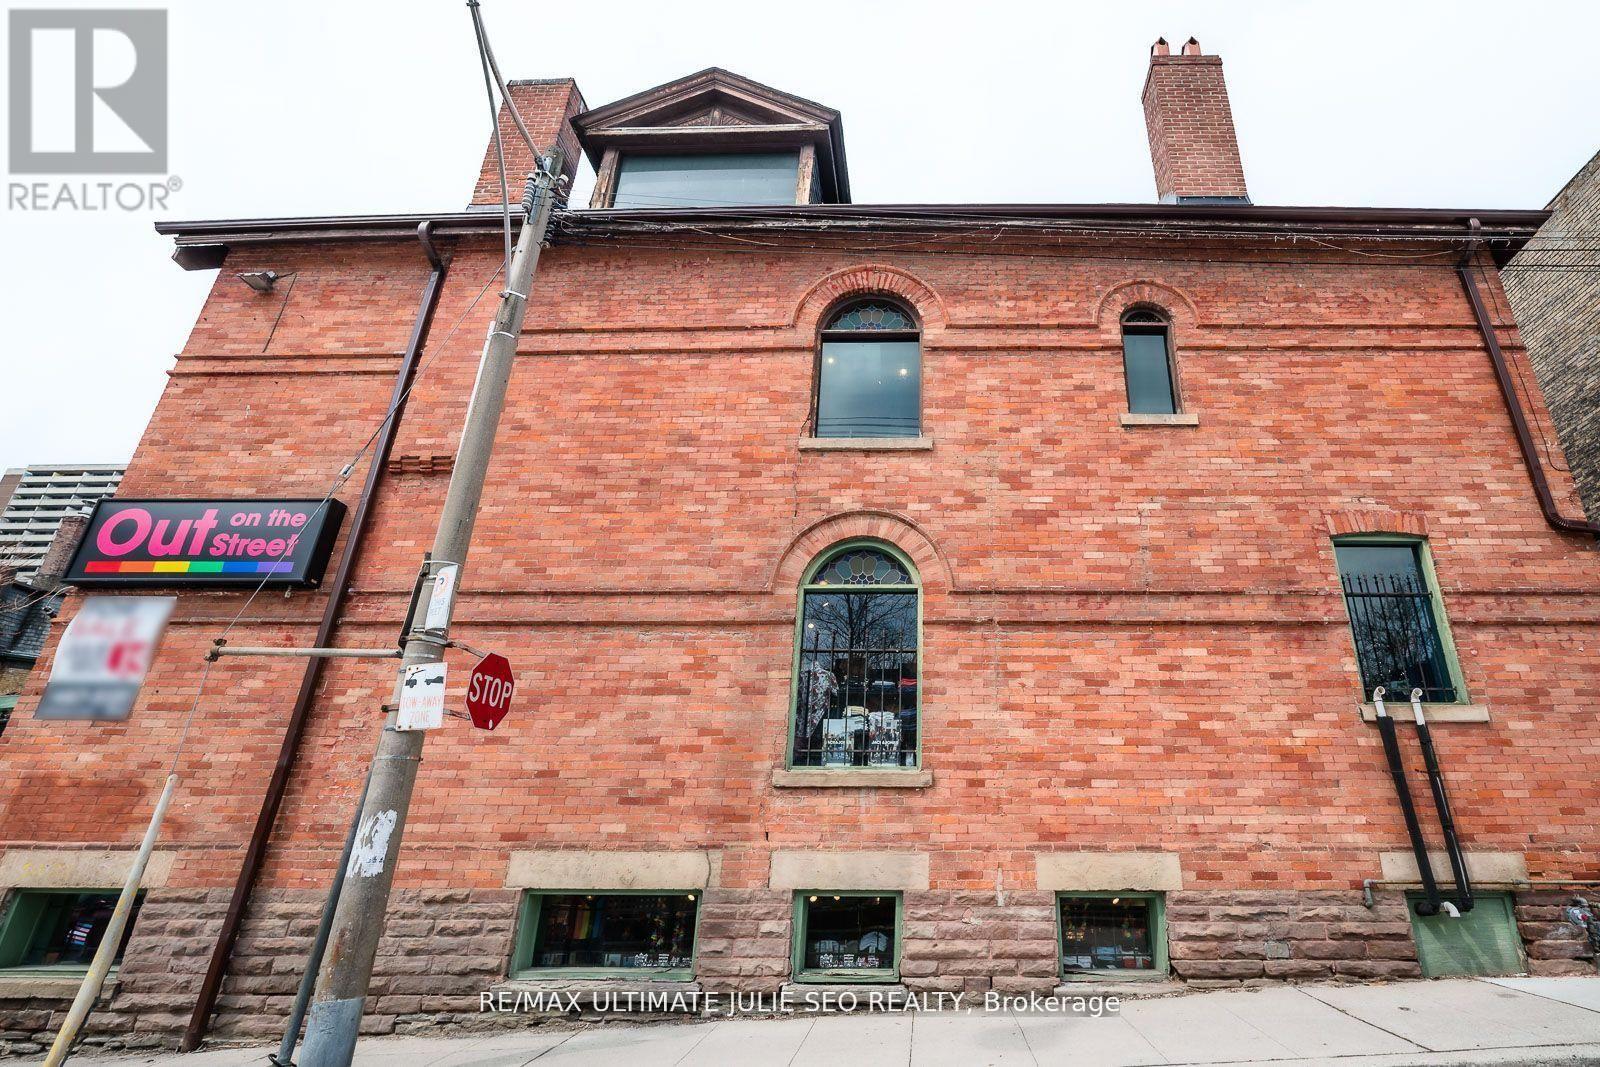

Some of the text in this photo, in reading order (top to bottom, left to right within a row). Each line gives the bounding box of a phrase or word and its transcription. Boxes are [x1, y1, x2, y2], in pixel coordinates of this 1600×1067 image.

[230, 509, 307, 527] on the
[96, 508, 219, 557] Out
[209, 533, 299, 557] Street
[469, 672, 512, 709] STOP
[401, 696, 442, 711] TOW-AWAY
